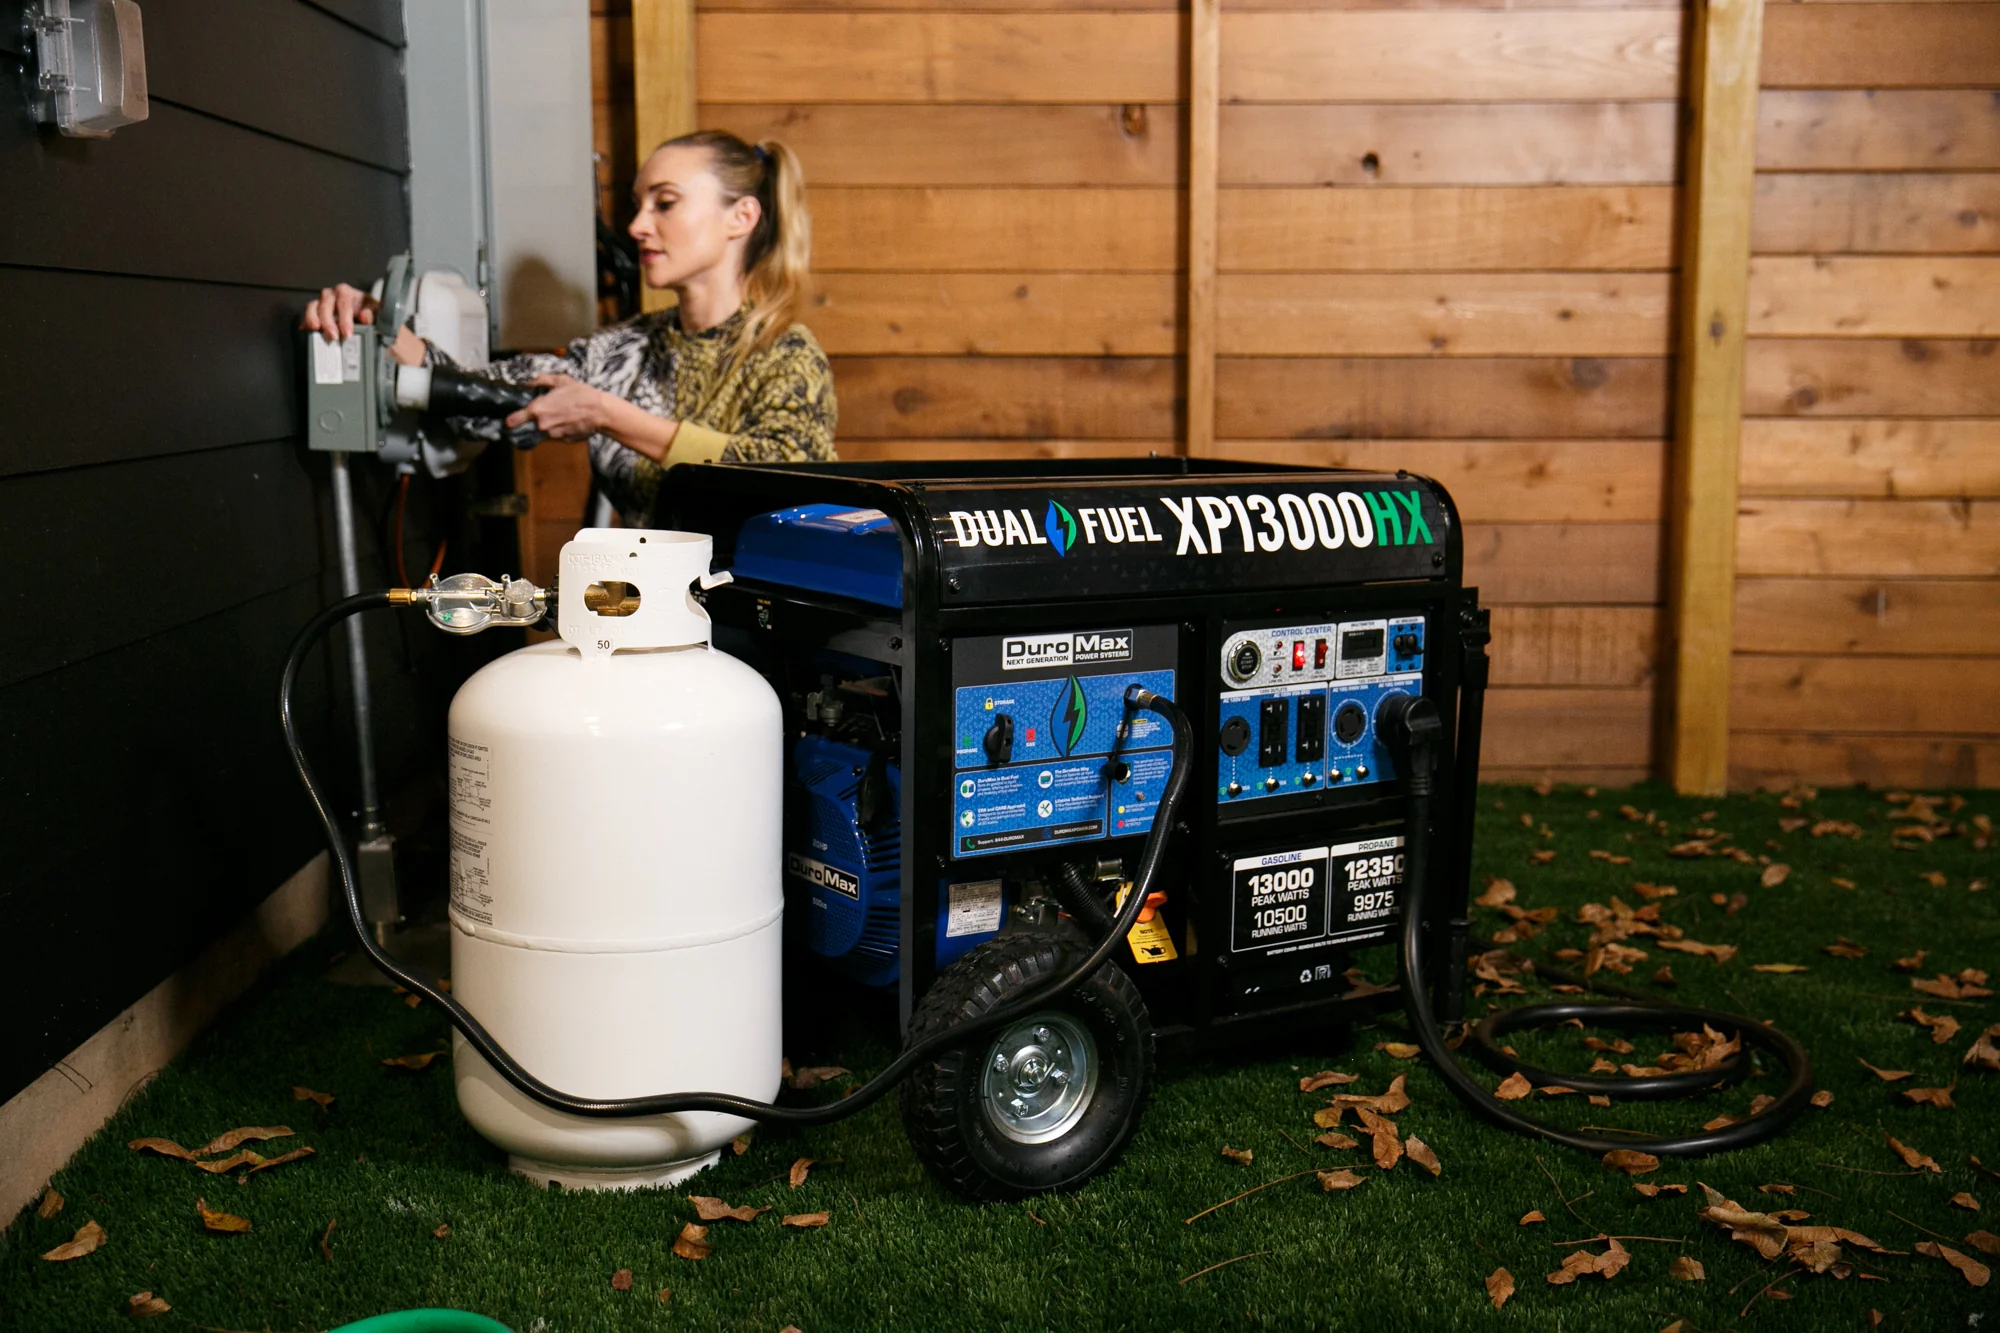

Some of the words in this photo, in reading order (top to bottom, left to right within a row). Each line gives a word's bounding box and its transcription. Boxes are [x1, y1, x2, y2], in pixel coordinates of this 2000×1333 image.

[949, 509, 1047, 547] DUAL
[1078, 507, 1163, 543] FUEL
[1160, 491, 1433, 556] XP13000HX
[1272, 628, 1303, 637] CONTROL
[1305, 626, 1332, 635] CENTER
[597, 640, 610, 649] 50
[1007, 634, 1129, 657] DuroMax
[1007, 658, 1024, 666] NEXT
[1026, 655, 1068, 664] GENERATION
[1075, 653, 1098, 661] POWER
[1100, 650, 1129, 659] SYSTEMS
[1358, 839, 1395, 851] PROPANE
[1261, 852, 1302, 865] GASOLINE
[790, 857, 857, 895] DuroMax
[1248, 867, 1314, 896] 13000
[1347, 878, 1371, 892] PEAK
[1371, 874, 1403, 888] WATTS
[1252, 893, 1276, 907] PEAK
[1277, 888, 1310, 903] WATTS
[1354, 890, 1395, 912] 9975
[1254, 904, 1307, 929] 10500
[1347, 909, 1378, 923] RUNNING
[1252, 925, 1283, 939] RUNNING
[1284, 921, 1307, 933] WATTS
